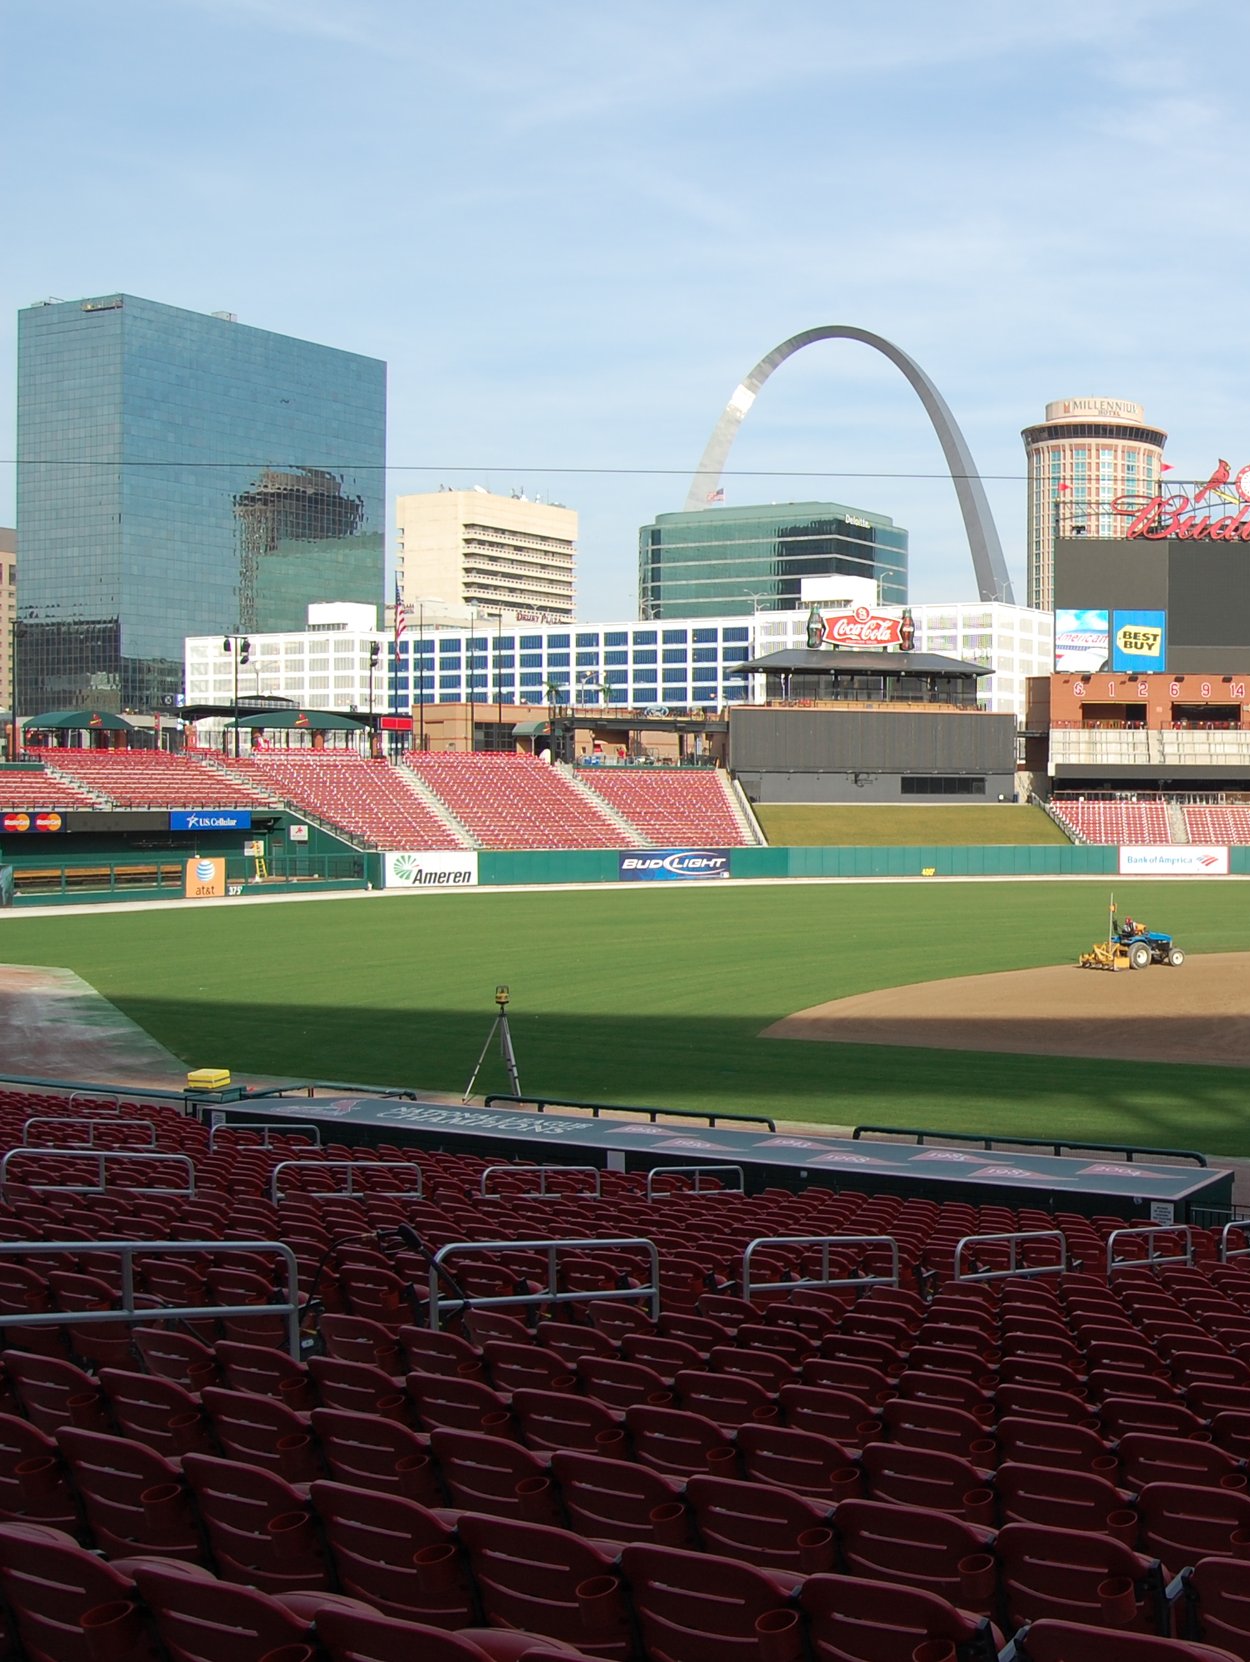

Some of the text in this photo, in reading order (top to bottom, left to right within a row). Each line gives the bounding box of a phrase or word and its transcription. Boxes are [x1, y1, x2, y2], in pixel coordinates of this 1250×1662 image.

[833, 618, 893, 641] Coca-Cola
[1122, 630, 1160, 642] BEST
[1123, 640, 1155, 651] BUY
[1108, 682, 1115, 696] 1
[1138, 682, 1148, 696] 2
[1169, 683, 1180, 696] 6
[1201, 683, 1211, 697] 9
[1230, 683, 1245, 697] 14
[212, 817, 237, 826] Cellular
[622, 858, 726, 869] BUD LIGHT
[412, 869, 471, 884] Ameren
[195, 886, 215, 895] at&t
